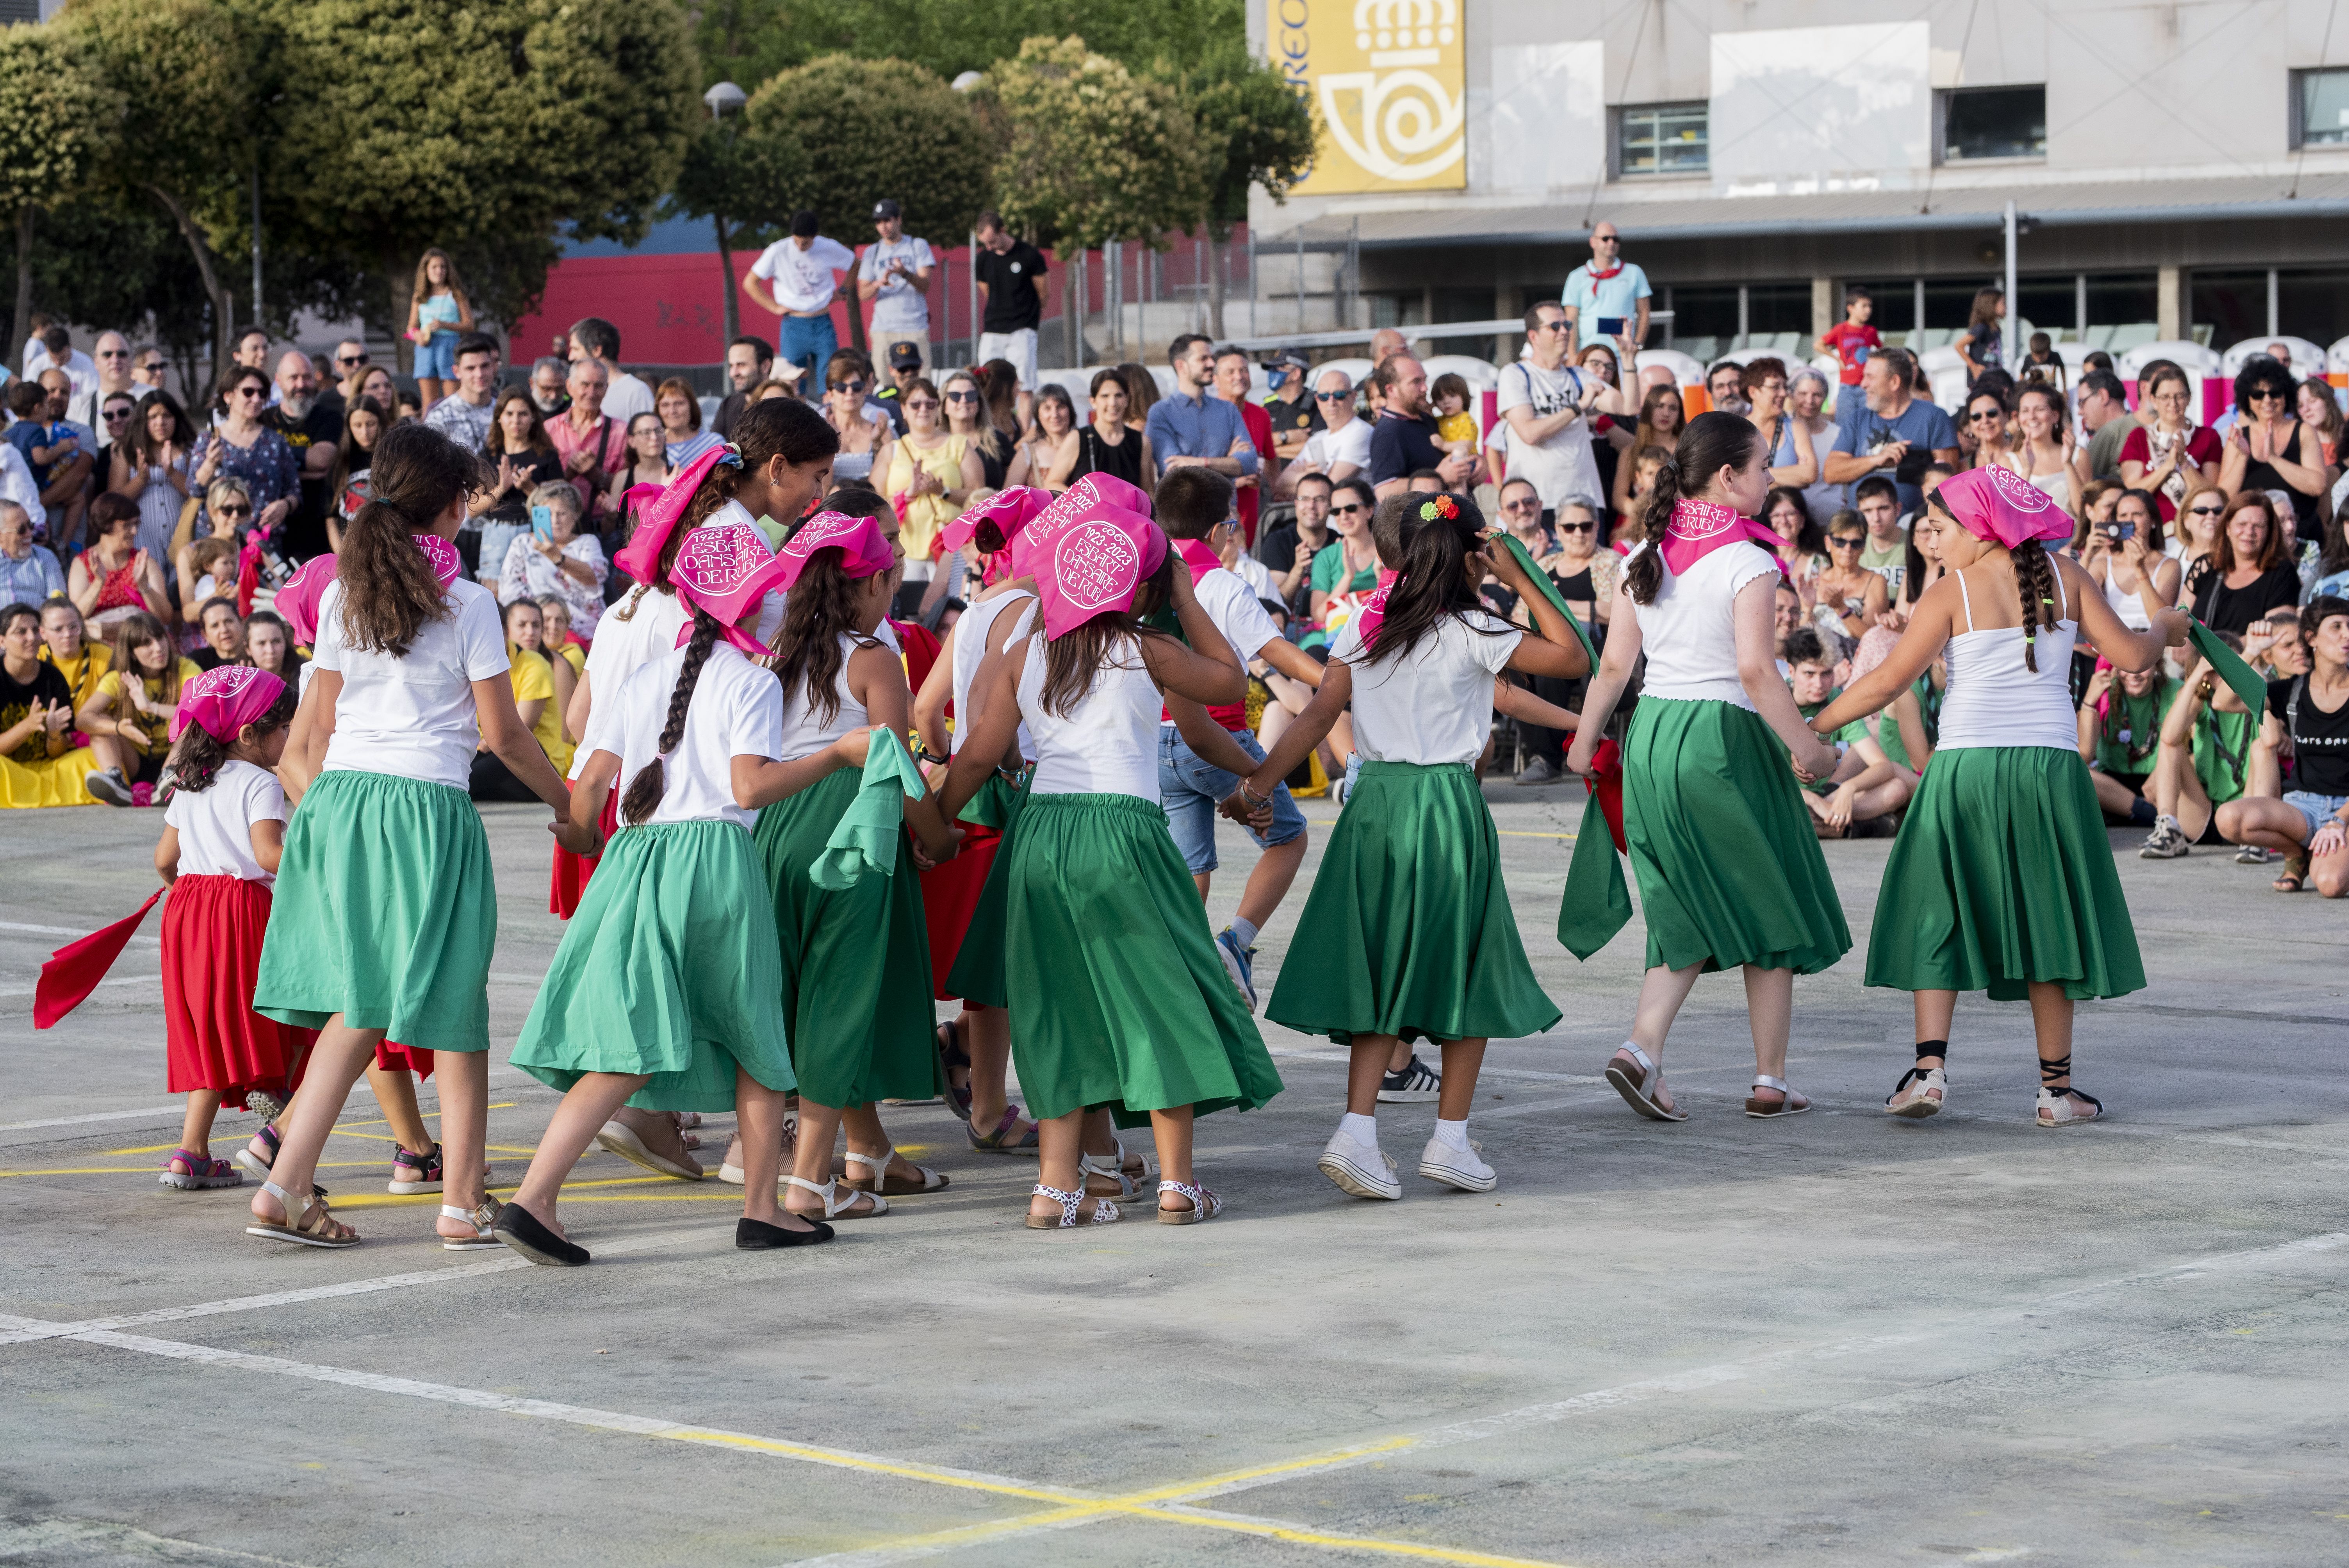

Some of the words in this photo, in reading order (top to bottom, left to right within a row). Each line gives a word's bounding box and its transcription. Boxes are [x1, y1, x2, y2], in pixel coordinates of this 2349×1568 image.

[1670, 514, 1686, 527] DE
[1675, 501, 1727, 522] ANSAIRE
[692, 535, 758, 554] ESBART
[694, 531, 723, 543] 1923
[1084, 527, 1106, 546] 1923
[1105, 542, 1132, 565] 2023
[684, 545, 768, 569] DANSAIRE
[1075, 537, 1124, 574] ESBART
[697, 570, 723, 585] DE
[1062, 567, 1080, 587] DE
[1063, 548, 1119, 592] DANSAIRE
